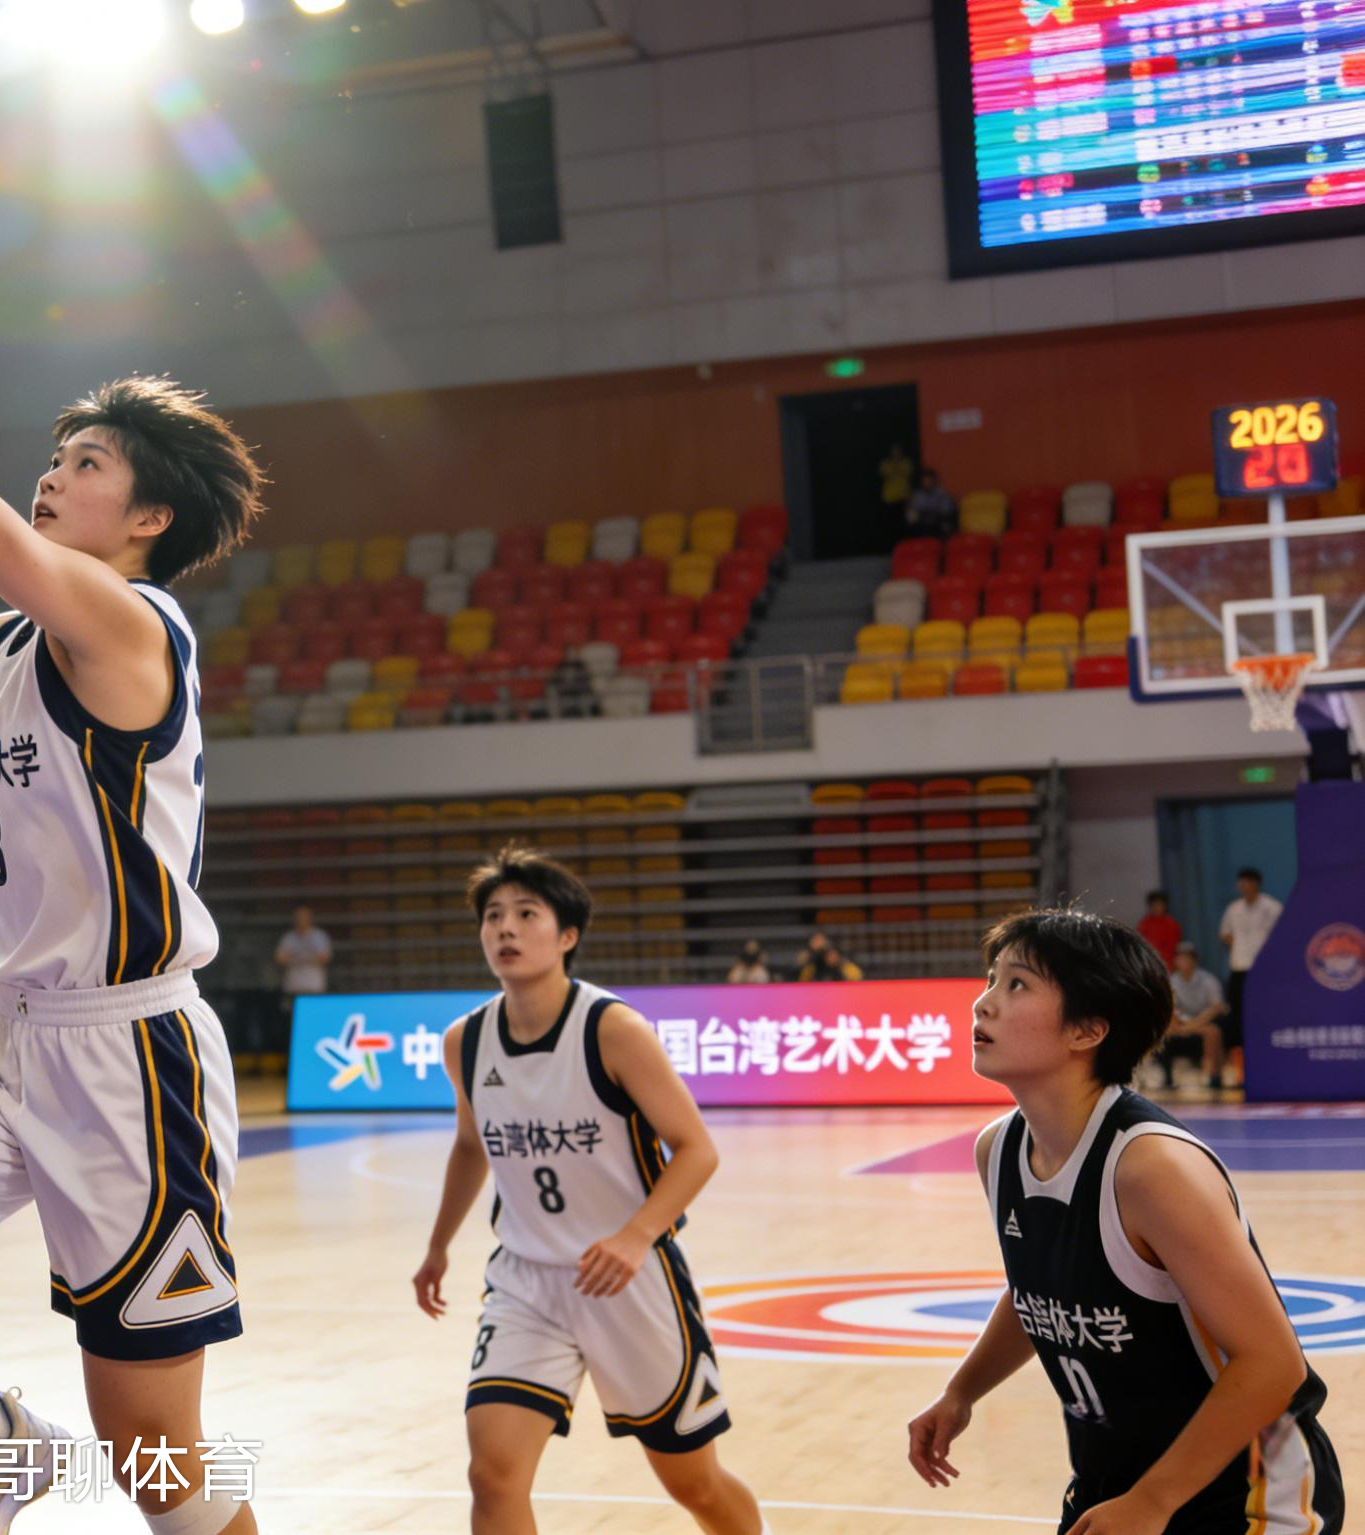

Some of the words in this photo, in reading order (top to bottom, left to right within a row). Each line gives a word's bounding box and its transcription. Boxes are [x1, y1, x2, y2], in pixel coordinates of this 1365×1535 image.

[1228, 401, 1325, 449] 2026
[648, 1012, 952, 1076] 国台湾艺术大学
[482, 1117, 603, 1158] 台湾体大学
[533, 1166, 566, 1214] 8
